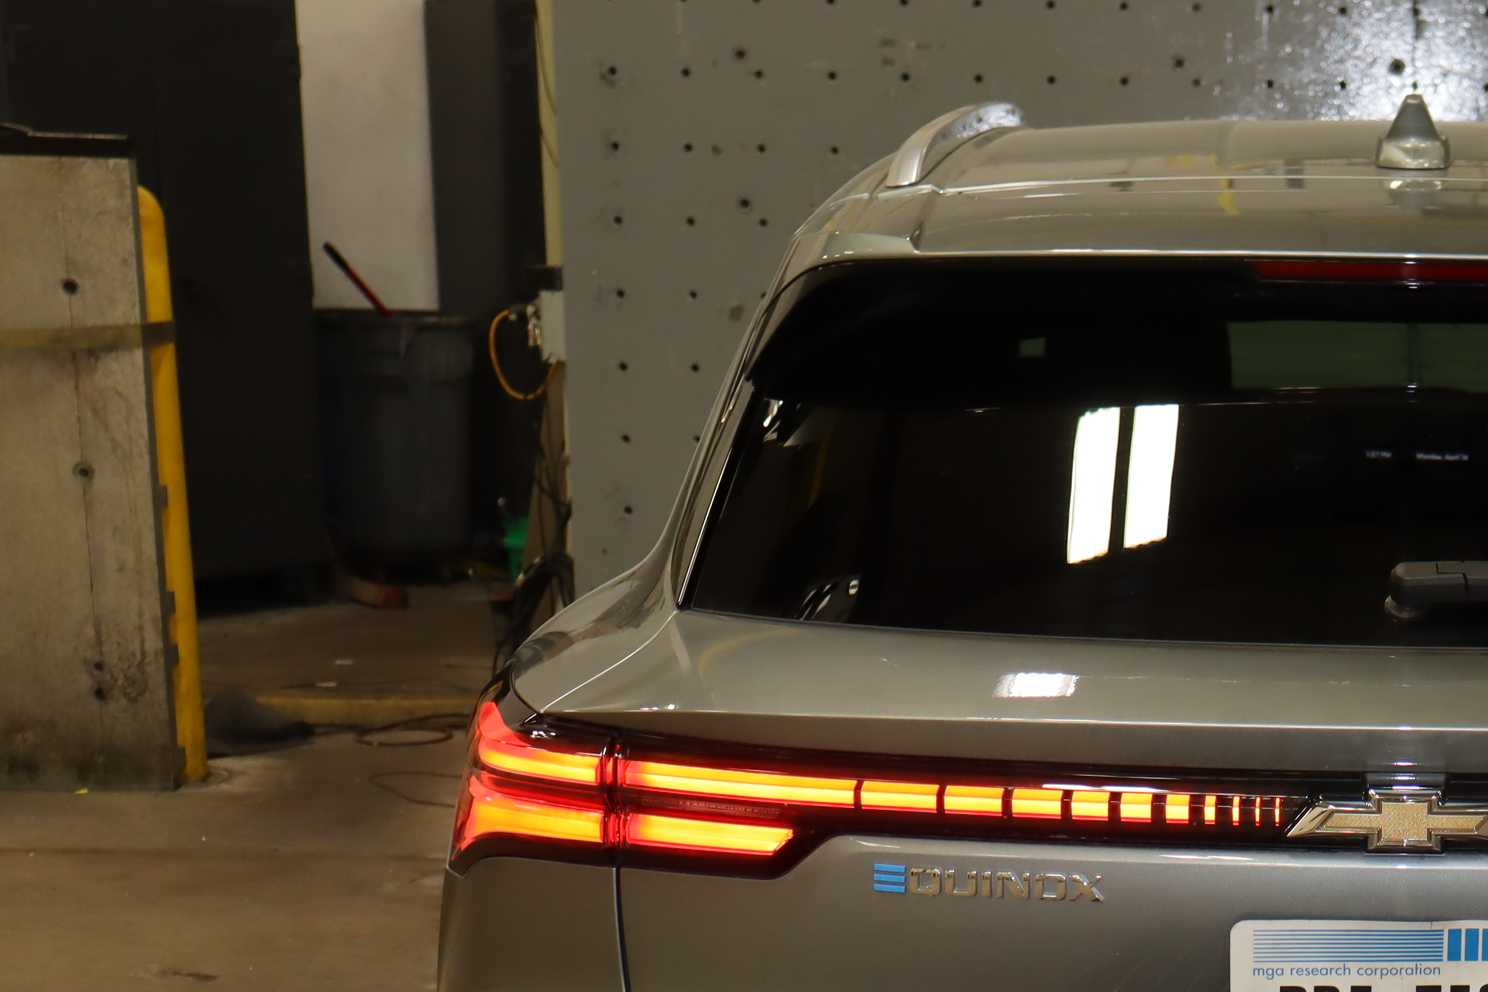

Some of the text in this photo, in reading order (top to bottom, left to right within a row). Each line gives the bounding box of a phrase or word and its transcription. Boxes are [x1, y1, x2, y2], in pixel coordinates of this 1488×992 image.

[873, 863, 1105, 902] EQUINOX
[1252, 963, 1442, 980] mga research corporation
